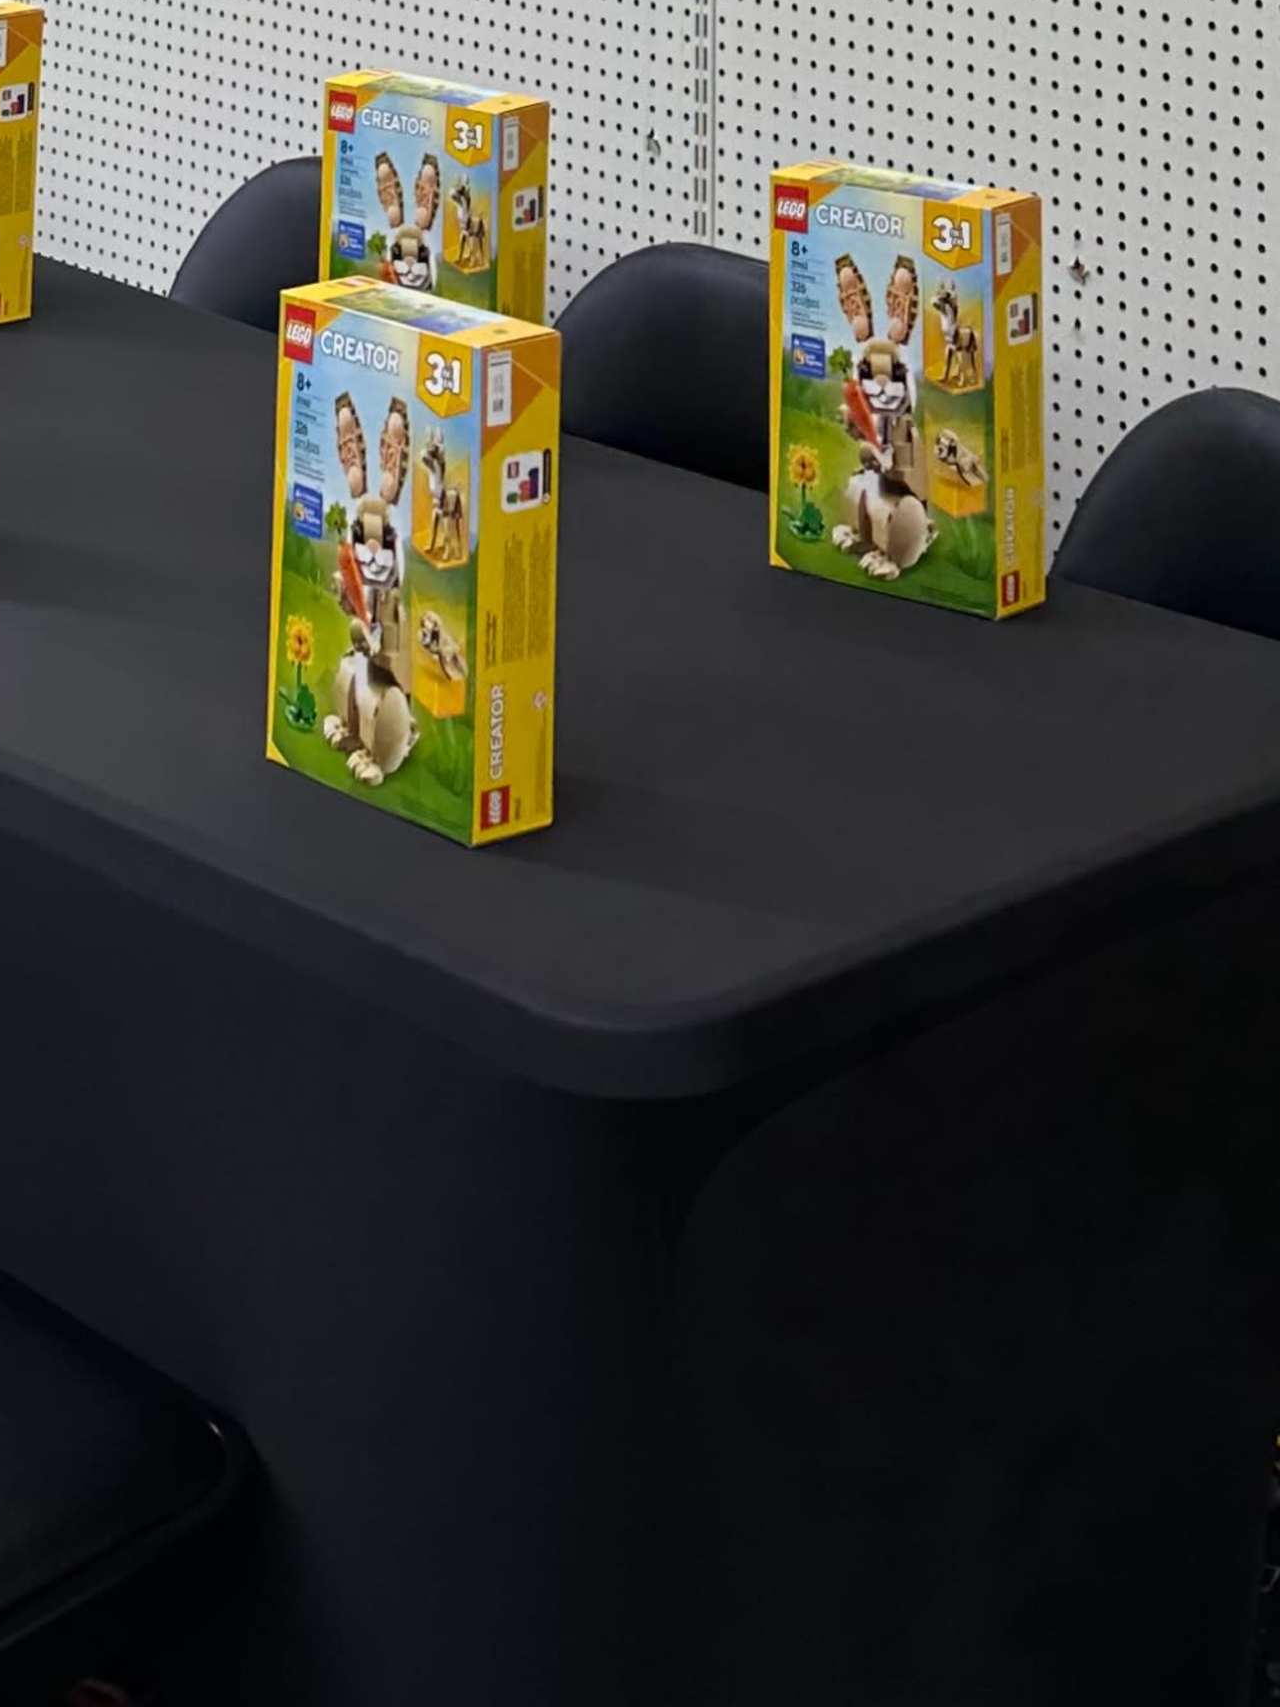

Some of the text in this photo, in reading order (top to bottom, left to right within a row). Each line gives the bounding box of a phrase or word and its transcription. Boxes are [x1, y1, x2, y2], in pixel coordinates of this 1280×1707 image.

[361, 108, 431, 137] CREATOR
[777, 198, 904, 237] LEGO CREATOR
[791, 240, 809, 256] 8+
[286, 321, 400, 375] LEGO CREATOR
[296, 372, 313, 391] 8+
[489, 684, 505, 781] CREATOR
